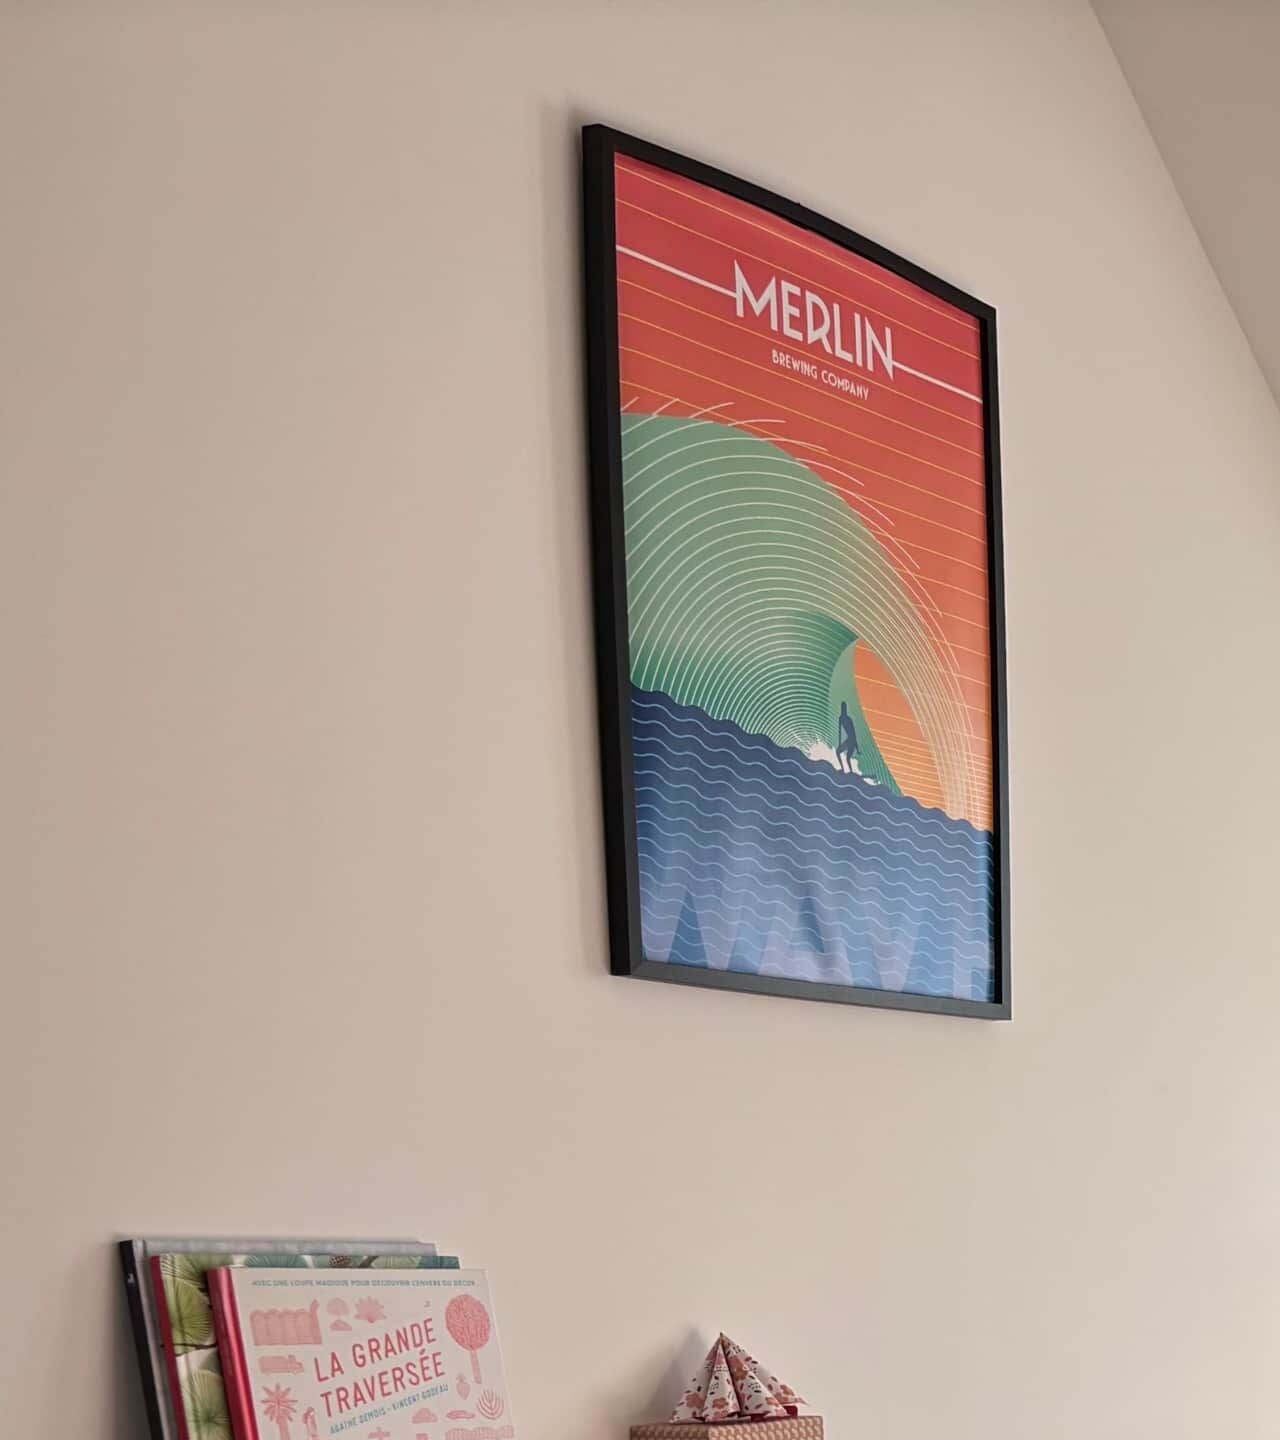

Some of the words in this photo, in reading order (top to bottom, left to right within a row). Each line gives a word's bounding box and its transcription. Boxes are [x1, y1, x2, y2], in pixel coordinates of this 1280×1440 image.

[734, 259, 894, 381] MERLIN
[771, 350, 818, 379] BREWING
[821, 370, 869, 400] COMPANY
[313, 1352, 345, 1383] LA
[352, 1318, 437, 1369] GRANDE
[320, 1348, 446, 1418] TRAVERSÉE
[330, 1417, 357, 1435] AGATHE
[392, 1393, 420, 1411] VINCENT
